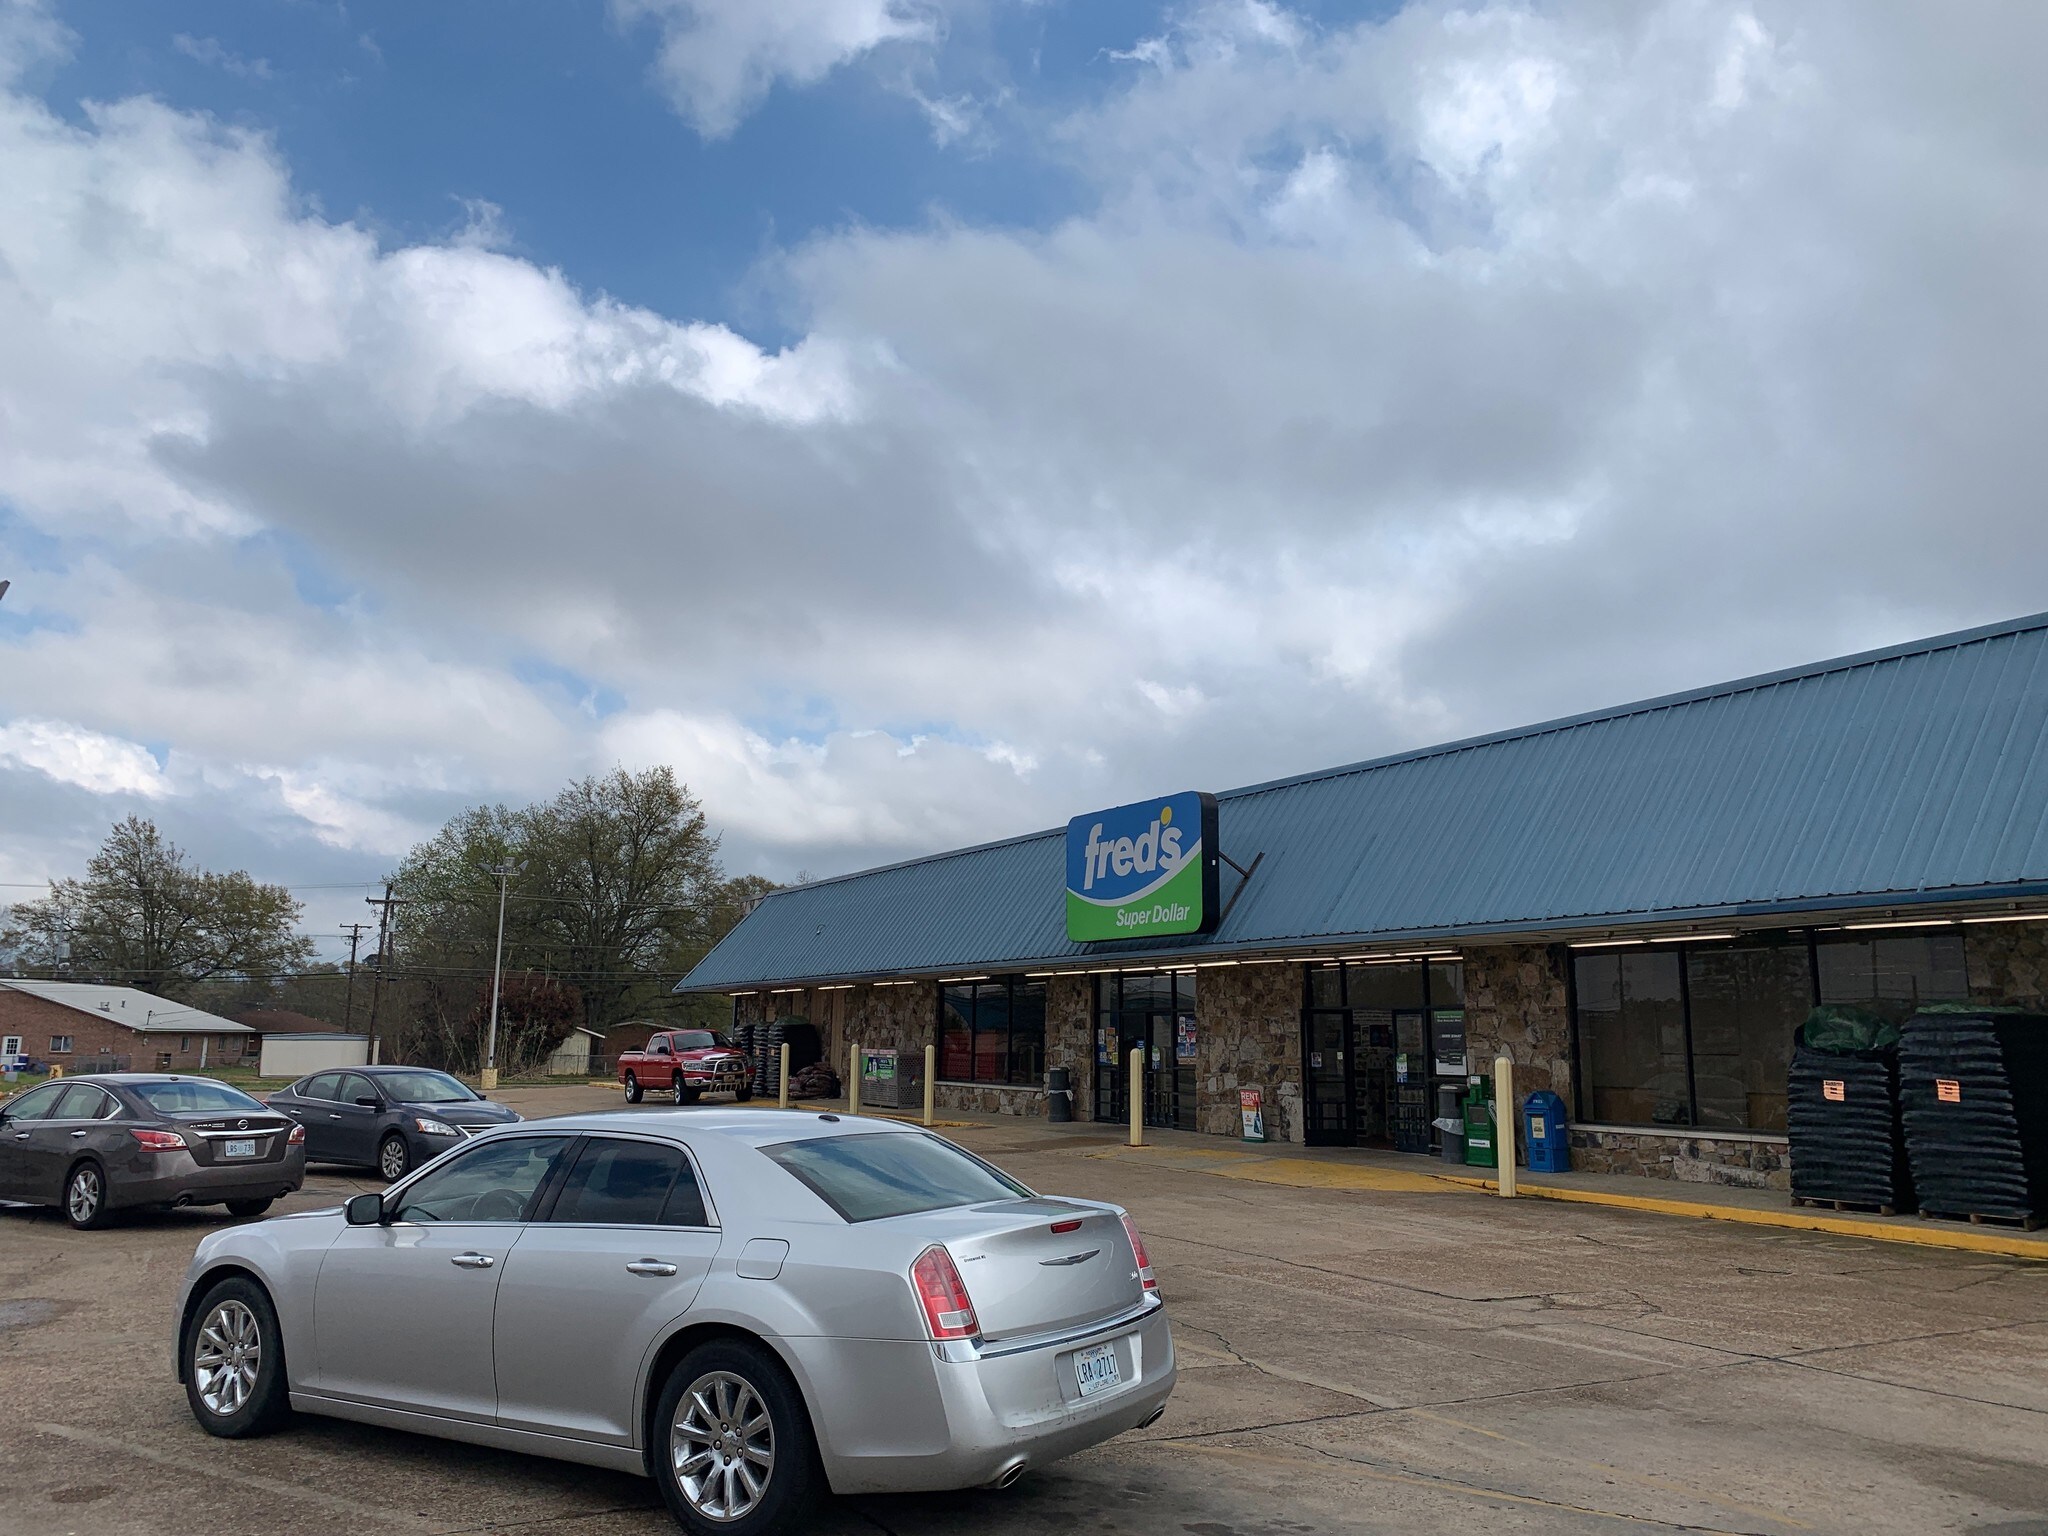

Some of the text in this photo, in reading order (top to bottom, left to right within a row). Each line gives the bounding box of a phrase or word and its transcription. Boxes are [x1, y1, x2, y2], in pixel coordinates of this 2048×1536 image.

[1083, 806, 1183, 890] fred's
[1116, 903, 1191, 929] Super Dollar
[1240, 1091, 1259, 1101] RENT
[1076, 1354, 1117, 1384] LRA 2717
